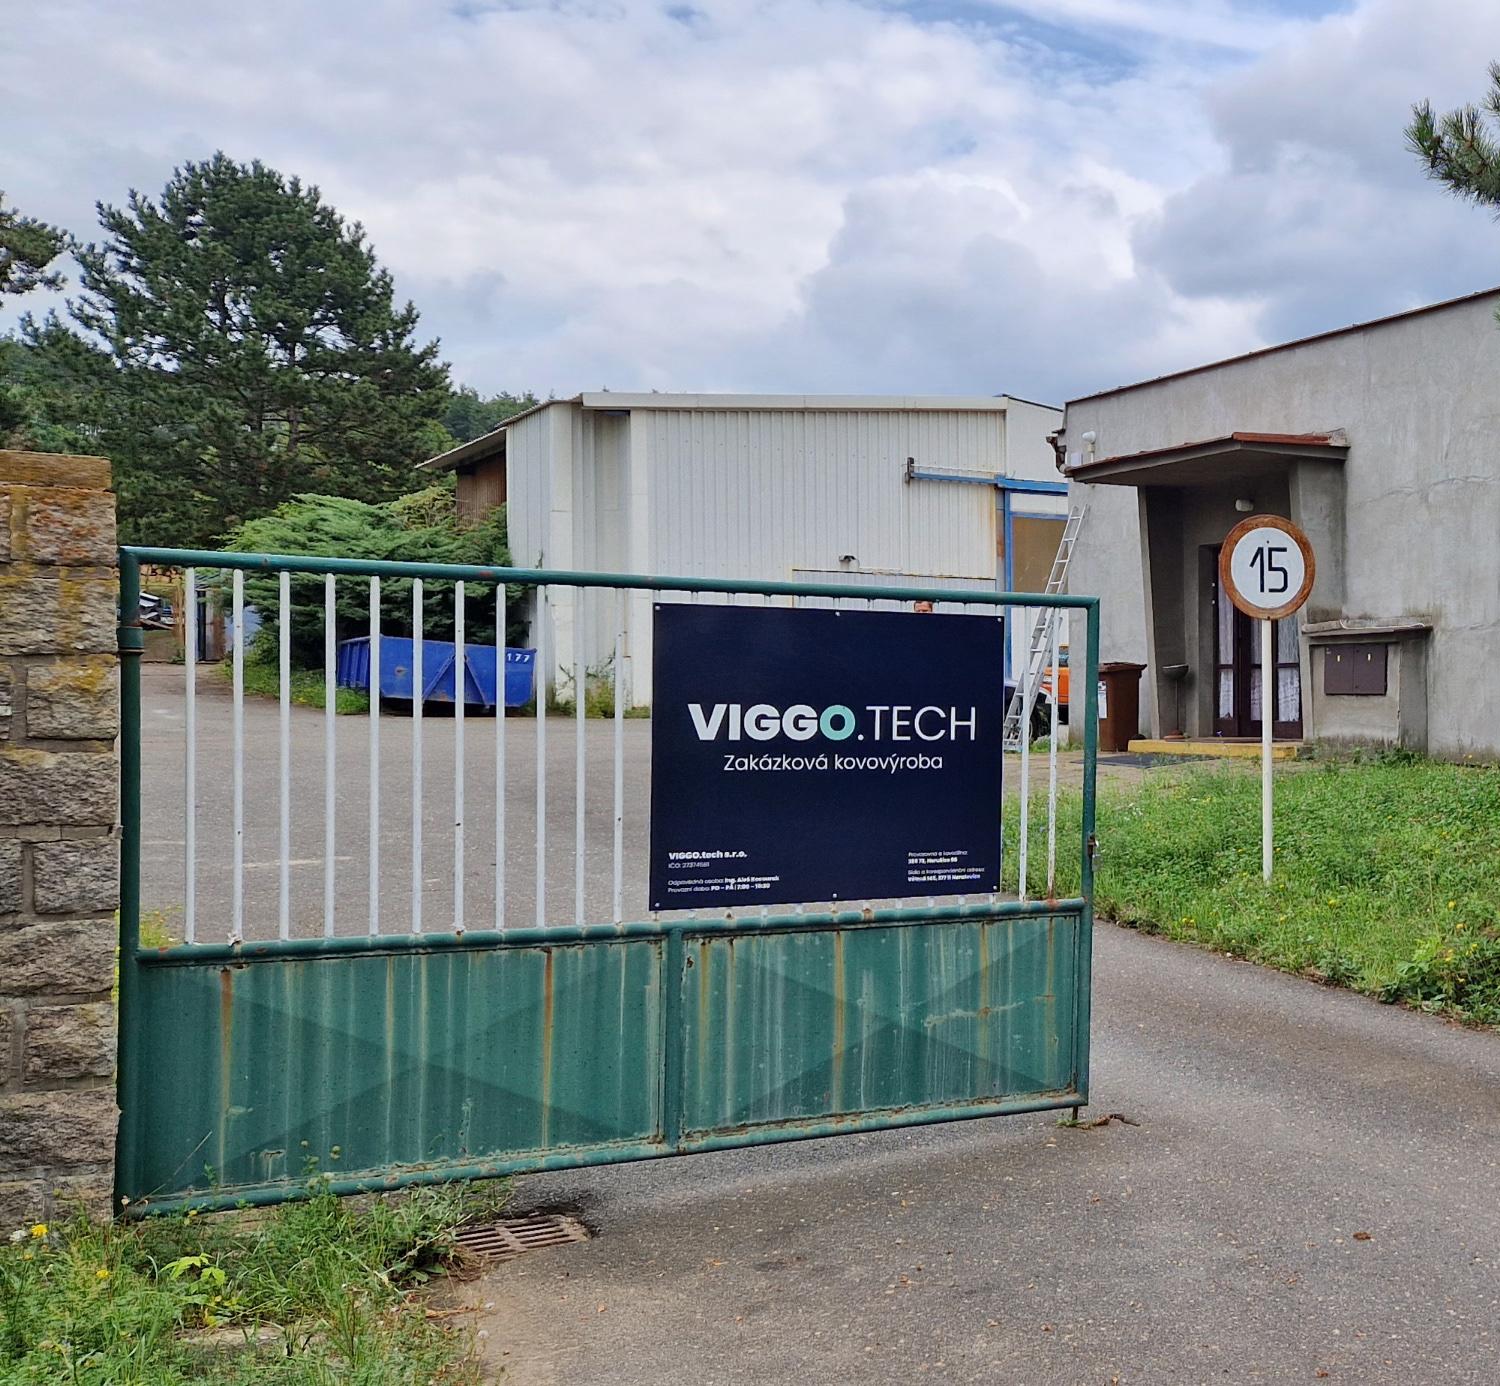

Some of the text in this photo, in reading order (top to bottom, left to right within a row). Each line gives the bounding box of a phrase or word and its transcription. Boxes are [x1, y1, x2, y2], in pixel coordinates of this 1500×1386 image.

[1248, 546, 1288, 593] 15
[687, 703, 977, 742] VIGGO.TECH
[723, 753, 943, 774] Zakázková kovovýroba
[668, 851, 723, 860] VIGGO.tech
